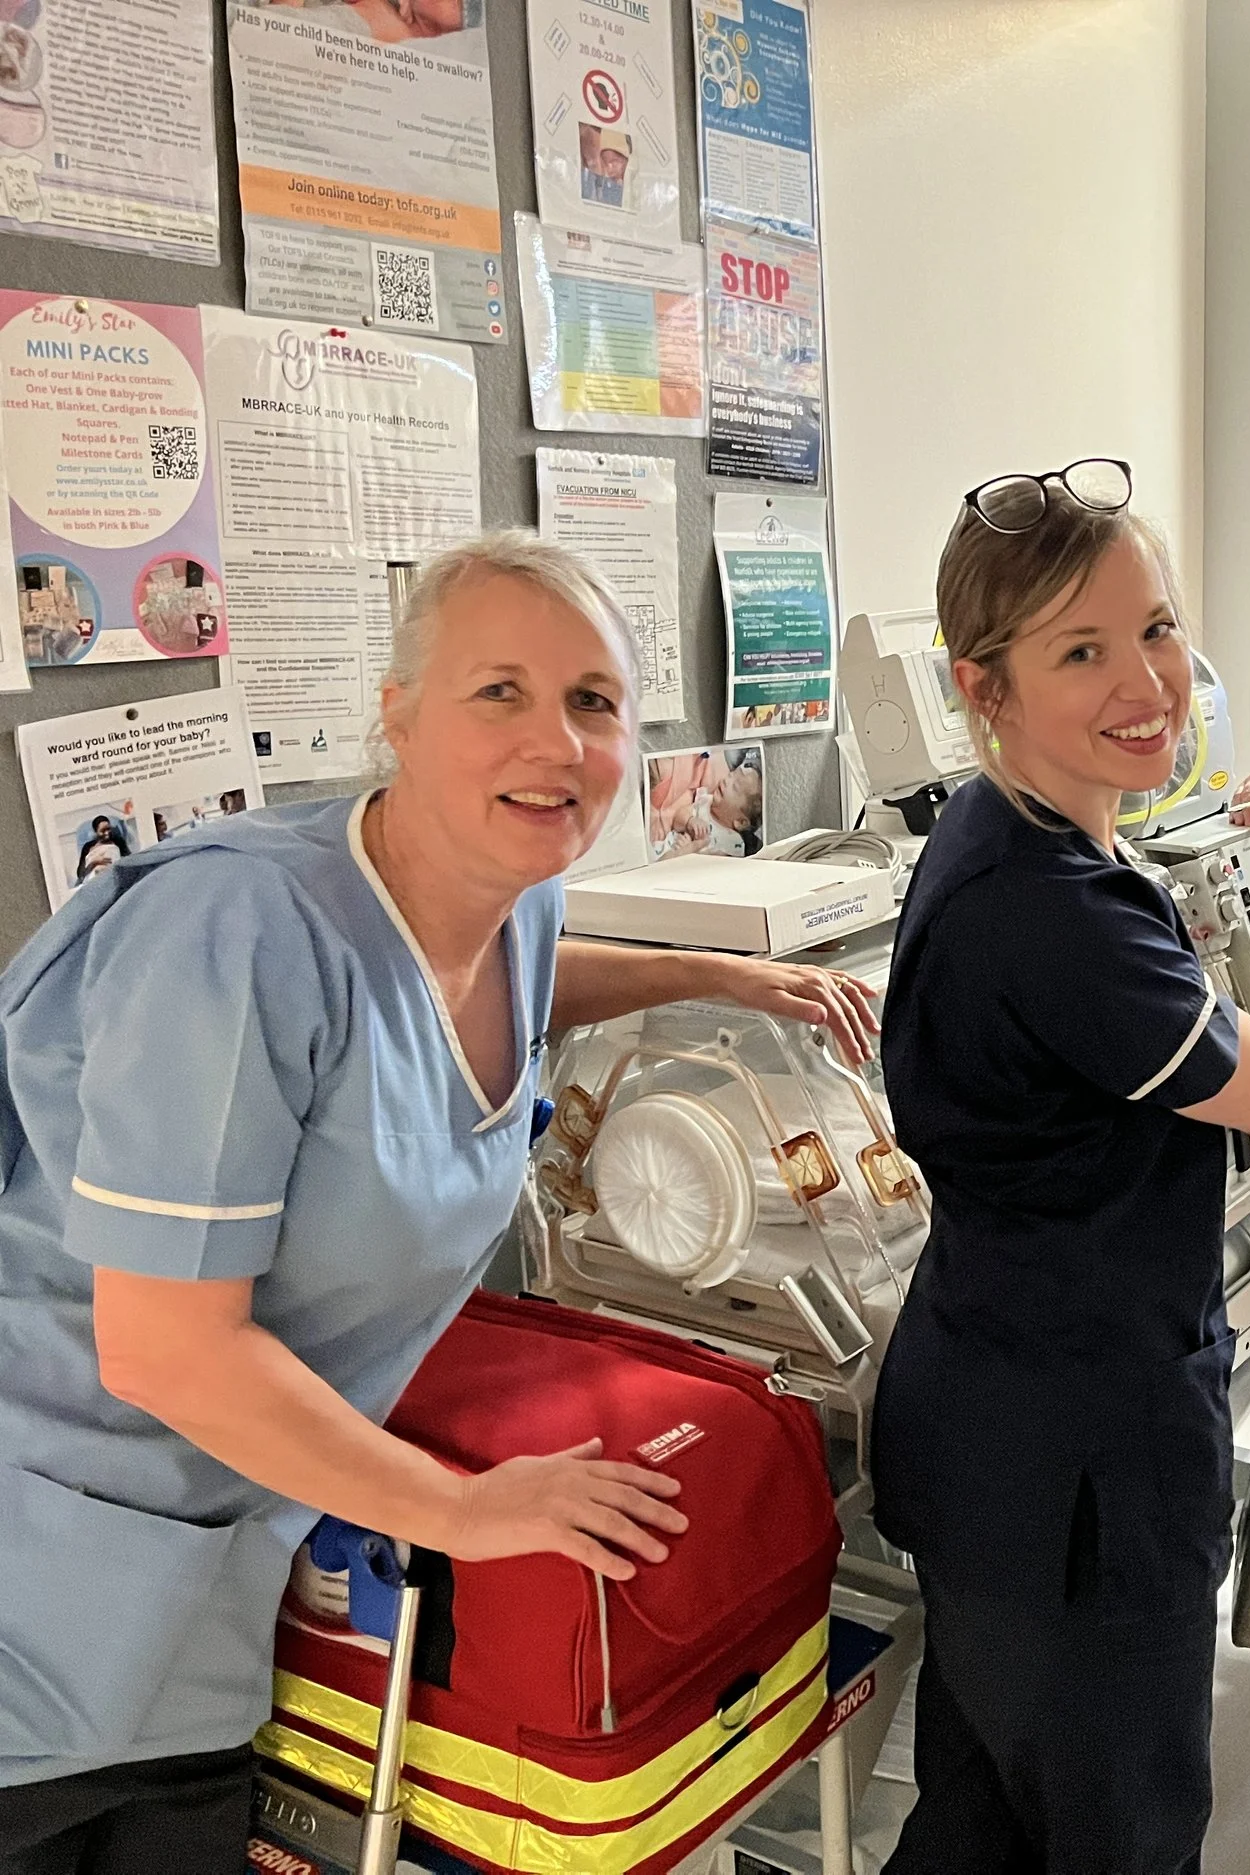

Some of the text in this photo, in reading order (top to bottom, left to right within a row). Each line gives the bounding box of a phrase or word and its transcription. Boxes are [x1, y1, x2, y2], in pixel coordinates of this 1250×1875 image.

[624, 0, 649, 20] TIME
[236, 8, 483, 82] Has your child been born unable to swallow?
[315, 45, 418, 82] We're here to help.
[288, 178, 457, 221] Join online today: tofs.org.uk
[721, 252, 790, 304] STOP
[26, 339, 150, 365] MINI PACKS
[9, 366, 35, 378] Each
[37, 367, 49, 378] of
[50, 371, 70, 380] our
[71, 370, 95, 381] Mini
[97, 372, 127, 383] Packs
[25, 383, 164, 401] One Vest & One Baby-grow
[31, 400, 54, 411] Hat,
[55, 401, 100, 413] Blanket,
[102, 403, 147, 417] Cardigan
[149, 405, 158, 415] &
[159, 406, 199, 420] Bonding
[242, 398, 450, 431] MBRRACE-UK and your Health Records
[76, 417, 121, 430] Squares.
[61, 432, 139, 445] Notepad & Pen
[61, 447, 144, 460] Milestone Cards
[556, 484, 599, 495] EVACUATION
[600, 487, 620, 496] FROM
[47, 507, 90, 517] Available
[74, 521, 97, 530] both
[98, 521, 119, 530] Pink
[130, 521, 150, 530] Blue
[47, 712, 229, 755] Would you like to lead the morning
[71, 728, 211, 765] ward round for your baby?
